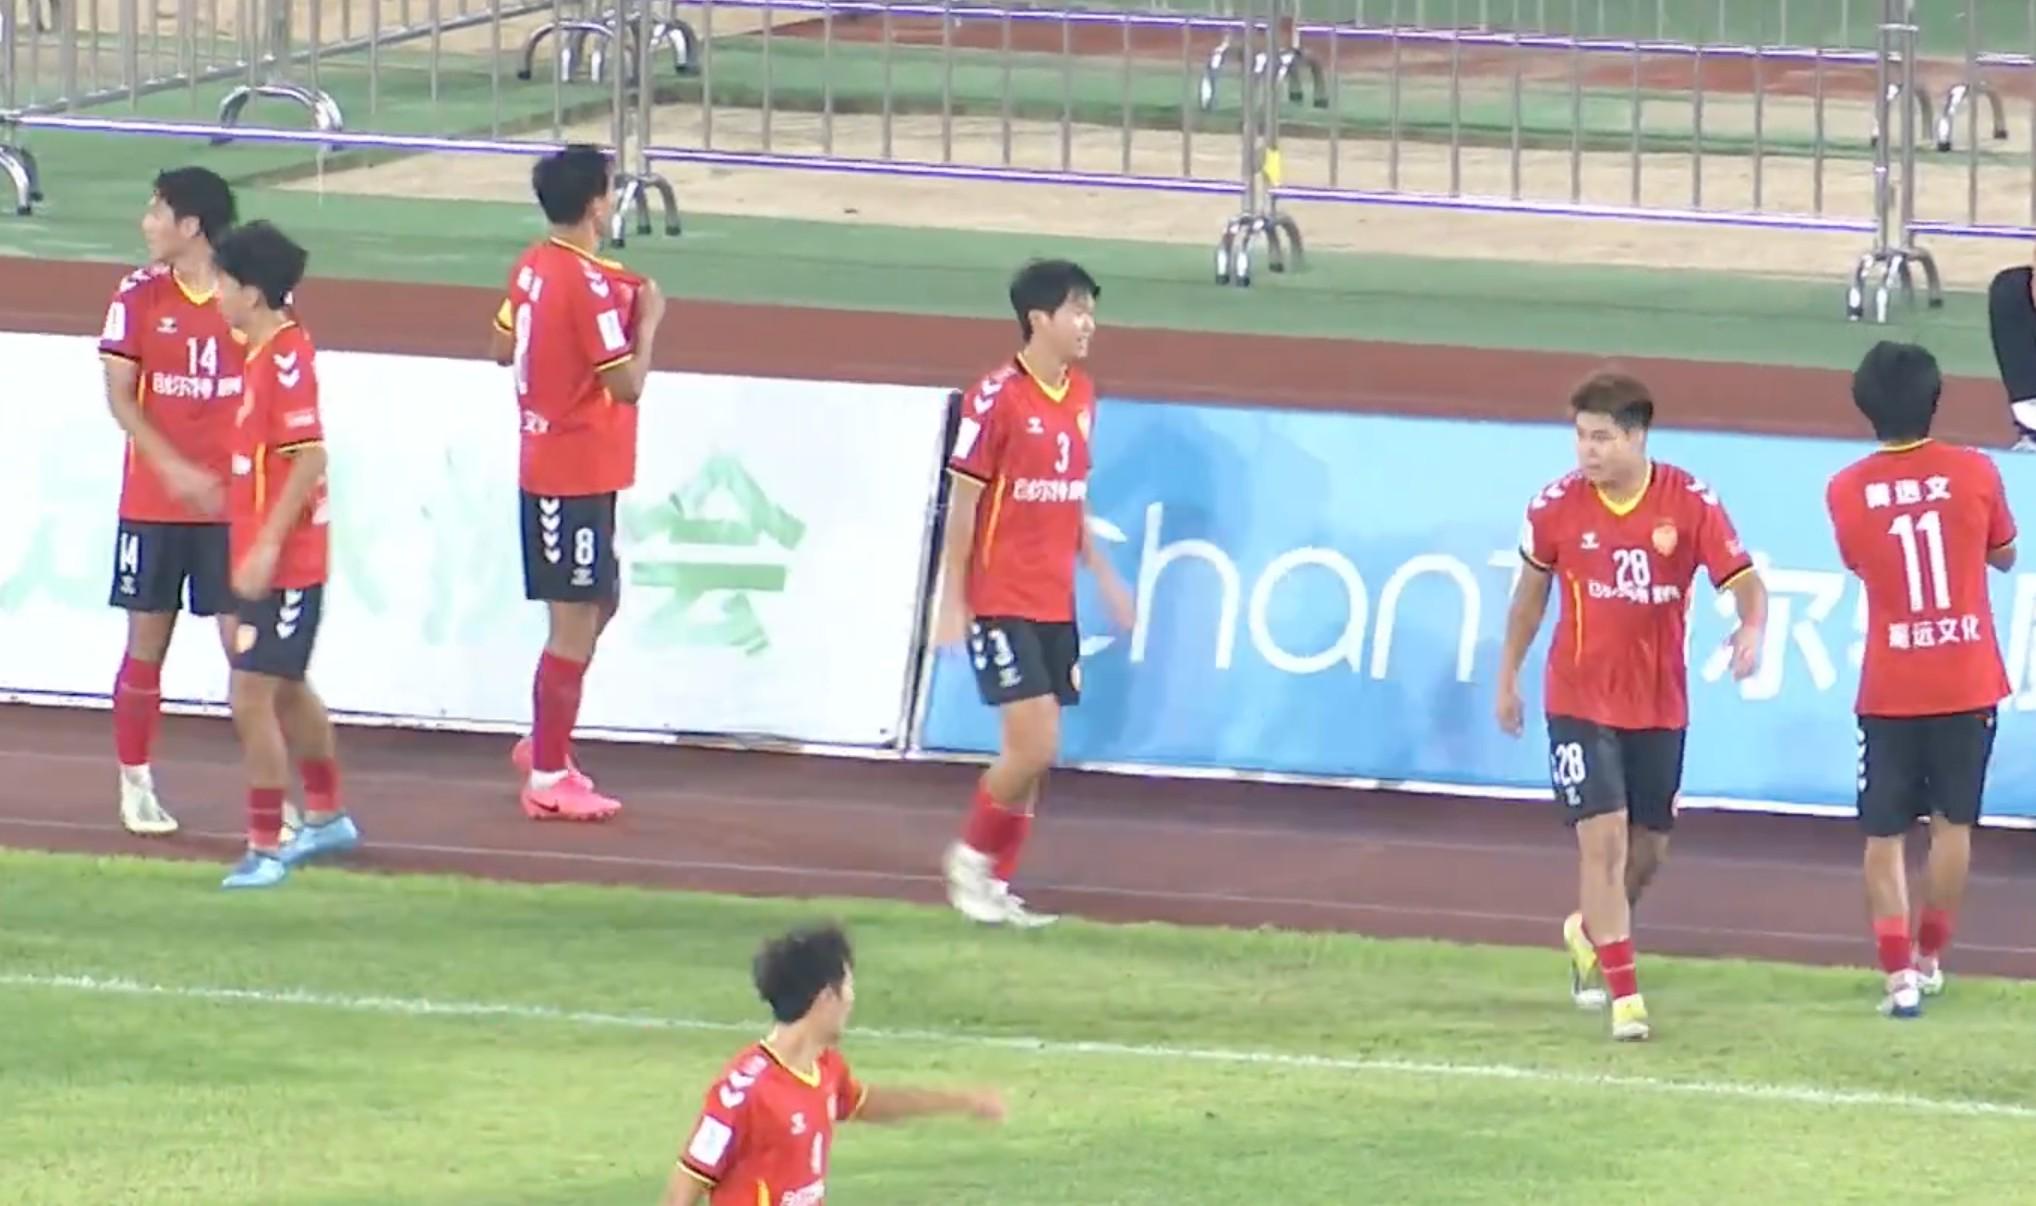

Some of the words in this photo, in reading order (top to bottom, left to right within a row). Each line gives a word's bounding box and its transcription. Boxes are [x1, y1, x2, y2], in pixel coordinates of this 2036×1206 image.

[187, 335, 218, 376] 14
[1055, 431, 1071, 474] 3
[574, 526, 596, 566] 8
[1888, 510, 1952, 613] 11
[1612, 548, 1652, 588] 28
[1083, 500, 1522, 684] han
[1555, 741, 1587, 787] 28
